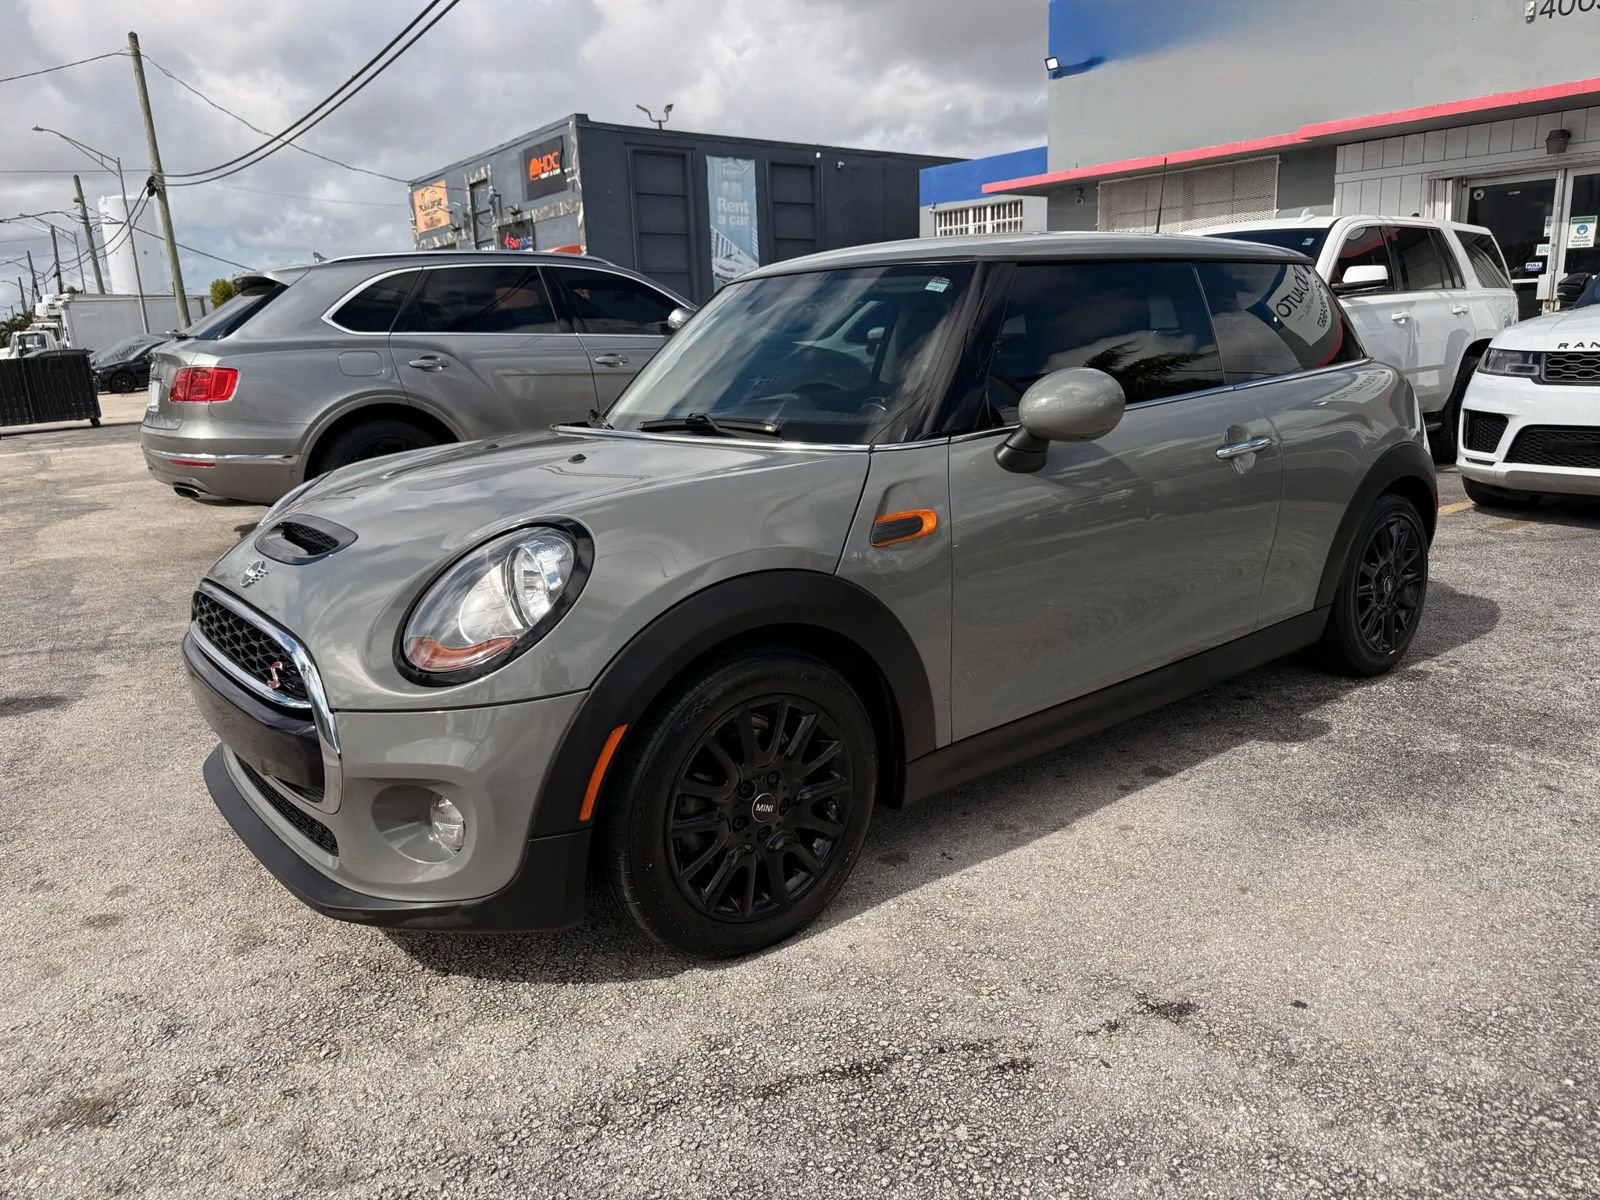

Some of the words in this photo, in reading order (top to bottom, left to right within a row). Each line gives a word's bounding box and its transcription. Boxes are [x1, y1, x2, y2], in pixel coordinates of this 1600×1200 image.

[1539, 0, 1600, 19] 400
[539, 151, 560, 173] HDC
[717, 198, 749, 213] Rent
[718, 213, 727, 225] a
[729, 214, 750, 225] car
[1557, 341, 1600, 349] RAN
[755, 803, 774, 813] MINI
